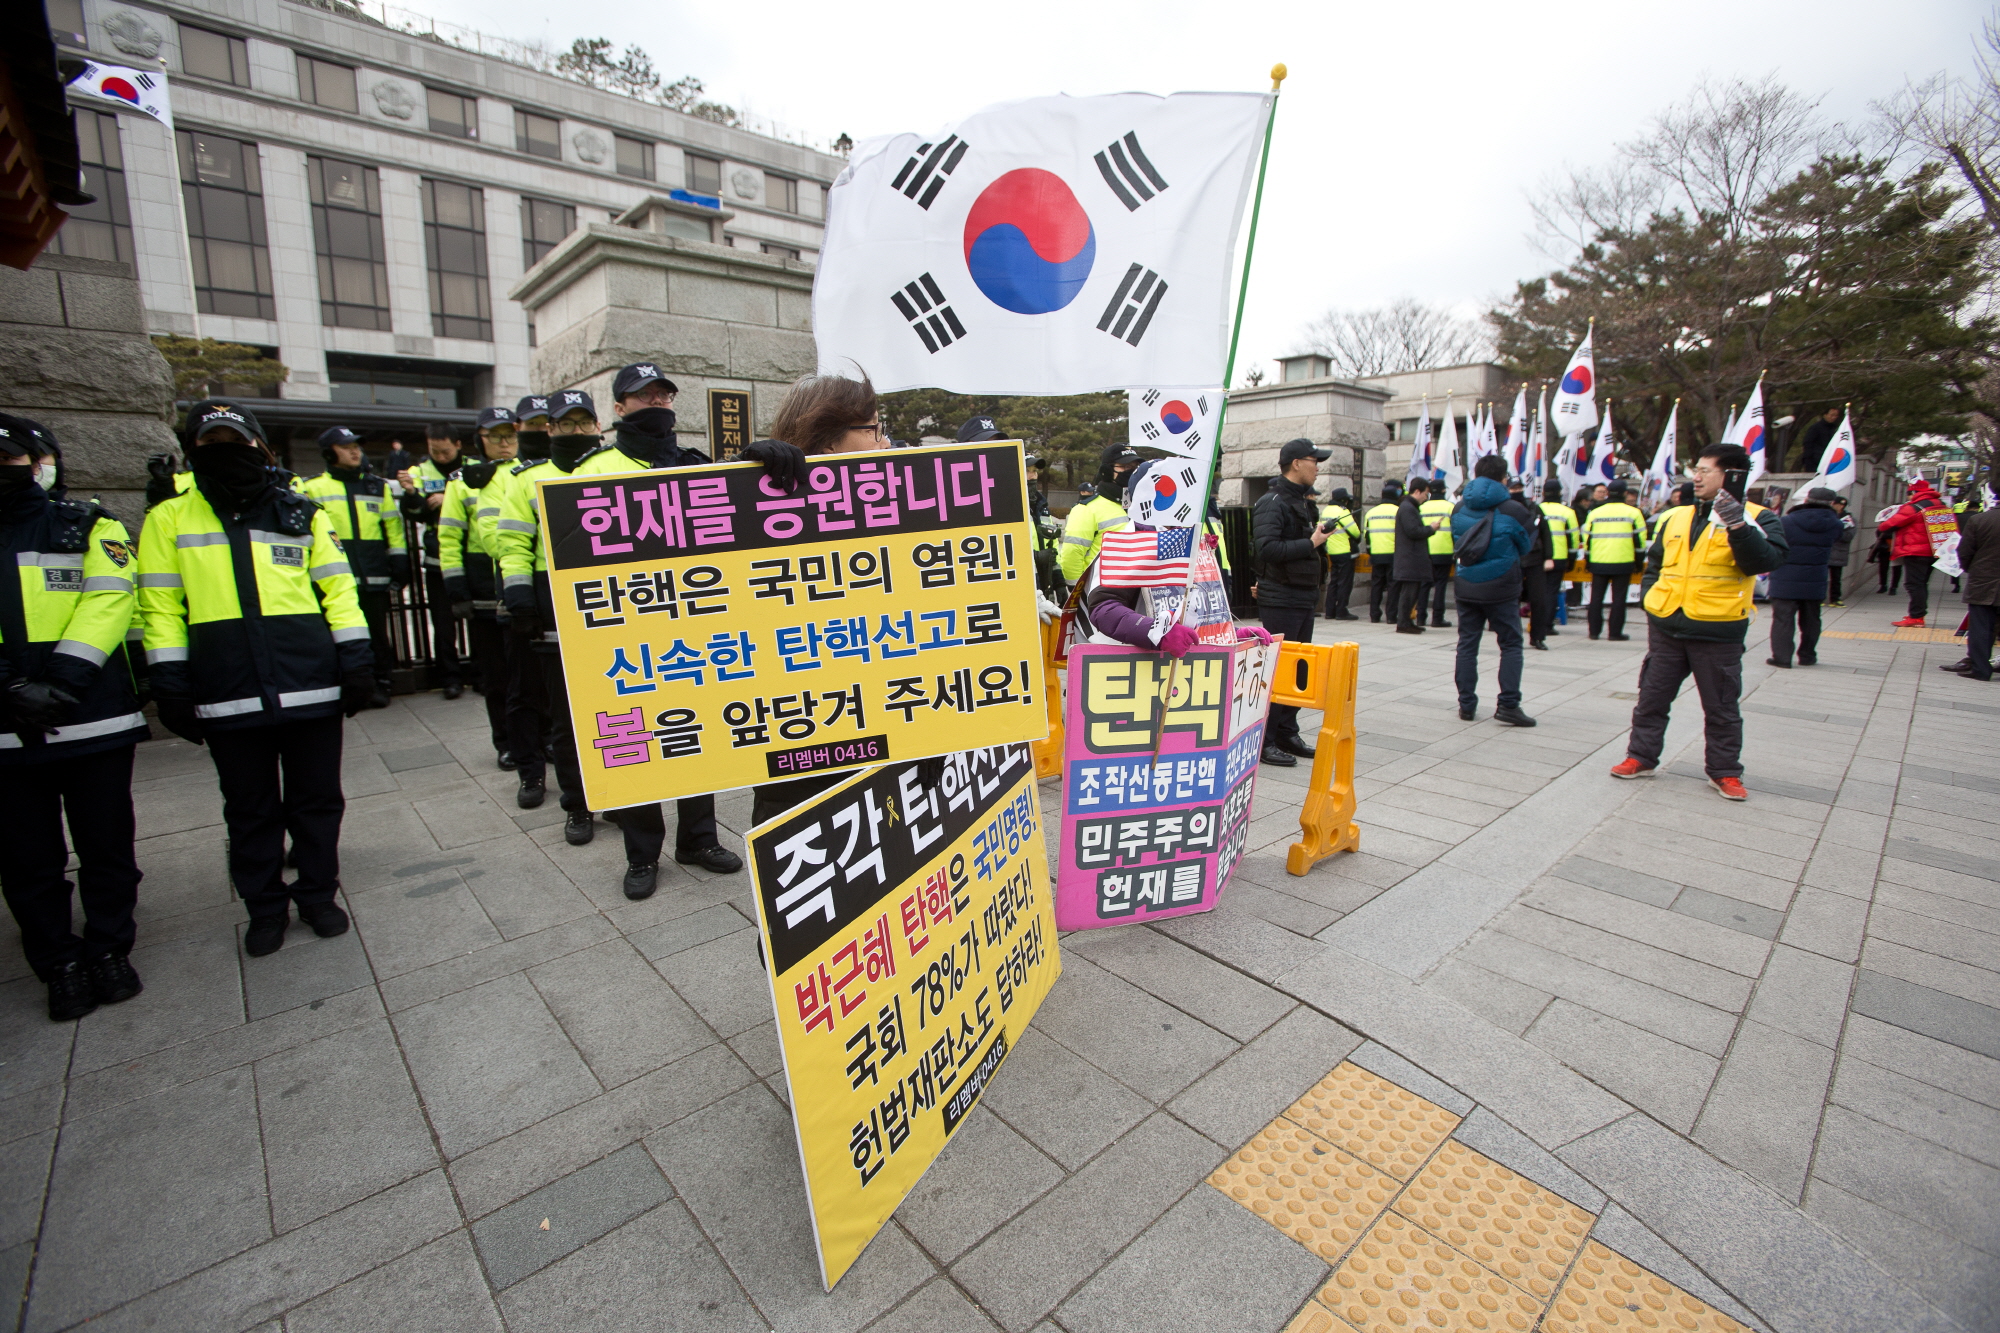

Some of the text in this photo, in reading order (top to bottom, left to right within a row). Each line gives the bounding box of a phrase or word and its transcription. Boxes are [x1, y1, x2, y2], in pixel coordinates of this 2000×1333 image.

[202, 411, 246, 424] POLICE
[576, 454, 996, 556] 헌재를 응원합니다
[275, 557, 301, 565] POLICE
[573, 533, 1017, 629] 탄핵은 국민의 염원!
[604, 629, 756, 696] 신속한
[776, 601, 1010, 673] 탄핵선고로
[593, 660, 1033, 769] 봄을 앞당겨 주세요!
[1087, 657, 1223, 746] 탄핵
[776, 741, 879, 772] 리멤버 0416
[1078, 757, 1217, 806] 조작선동탄핵
[1080, 811, 1216, 863] 민주주의
[1221, 776, 1254, 838] 최후보루
[773, 788, 887, 930] 즉각
[1102, 866, 1201, 914] 헌재를
[1216, 819, 1248, 889] 믿습니다
[793, 783, 1037, 1033] 박근혜 탄핵은 국민명령!
[844, 857, 1035, 1091] 국회 78%가 따랐다!
[848, 913, 1045, 1189] 헌법재판소도 답하라!
[948, 1039, 1004, 1123] 리멤버 0416
